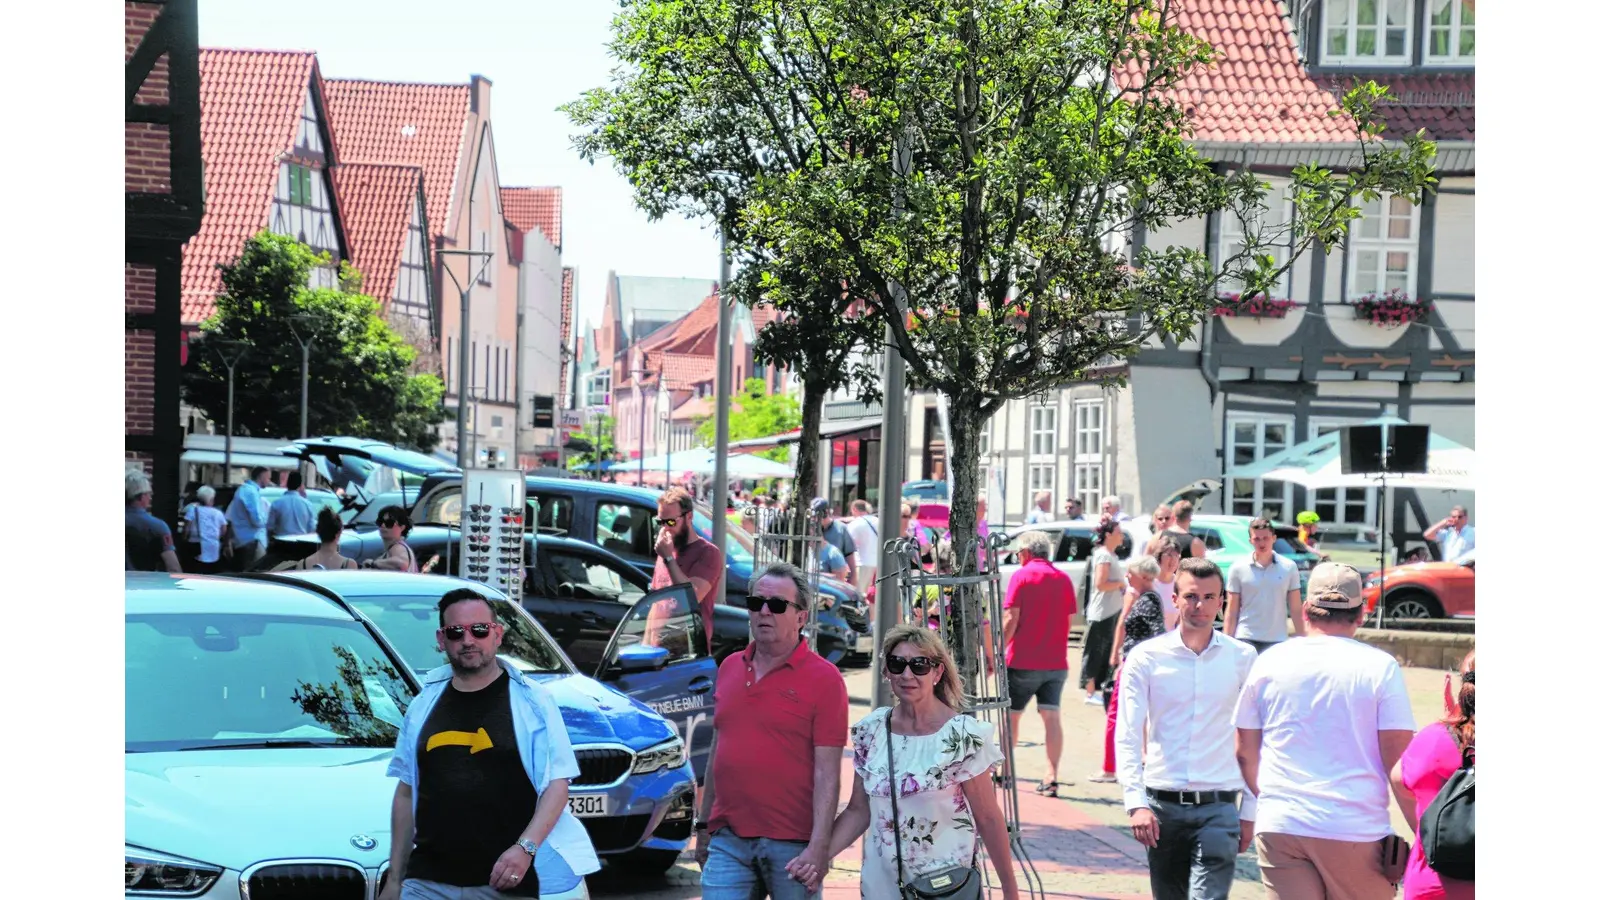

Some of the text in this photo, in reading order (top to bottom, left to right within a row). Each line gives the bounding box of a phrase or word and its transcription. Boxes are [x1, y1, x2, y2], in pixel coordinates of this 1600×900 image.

[562, 413, 579, 425] dm
[658, 699, 682, 714] NEUE
[682, 694, 704, 710] BMW
[568, 796, 604, 814] 3301
